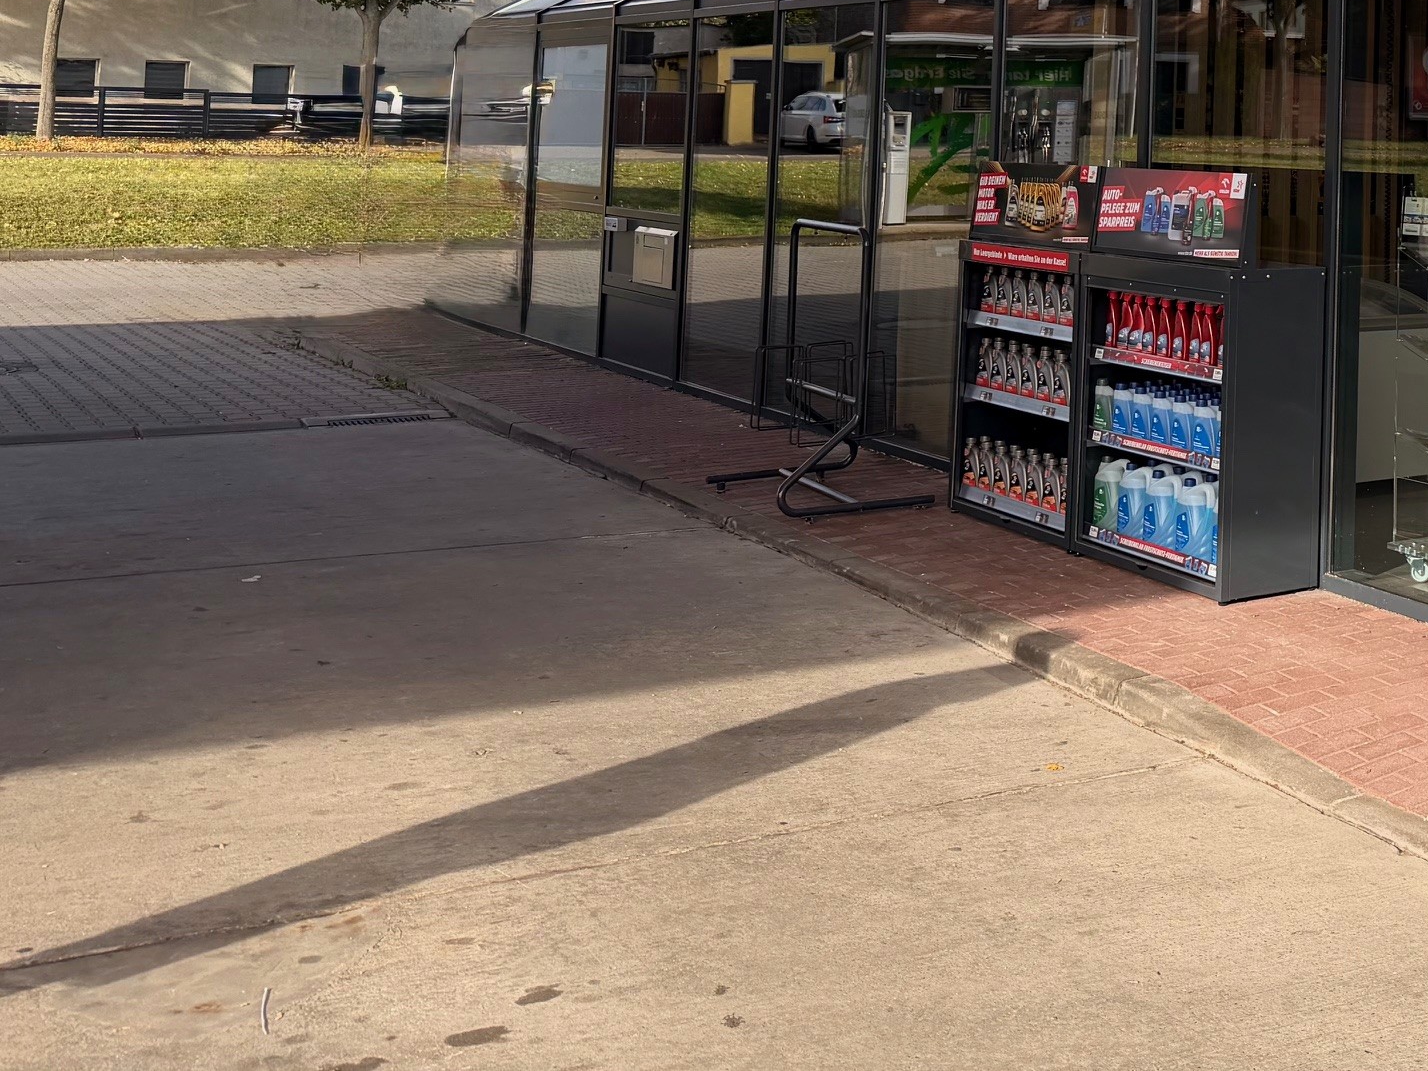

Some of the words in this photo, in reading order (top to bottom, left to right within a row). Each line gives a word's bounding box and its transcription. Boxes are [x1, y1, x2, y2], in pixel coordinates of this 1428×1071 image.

[1102, 189, 1123, 201] AUTO-
[1100, 202, 1125, 214] PFLEGE
[1126, 202, 1141, 213] ZUM
[1098, 216, 1135, 228] SPARPREIS
